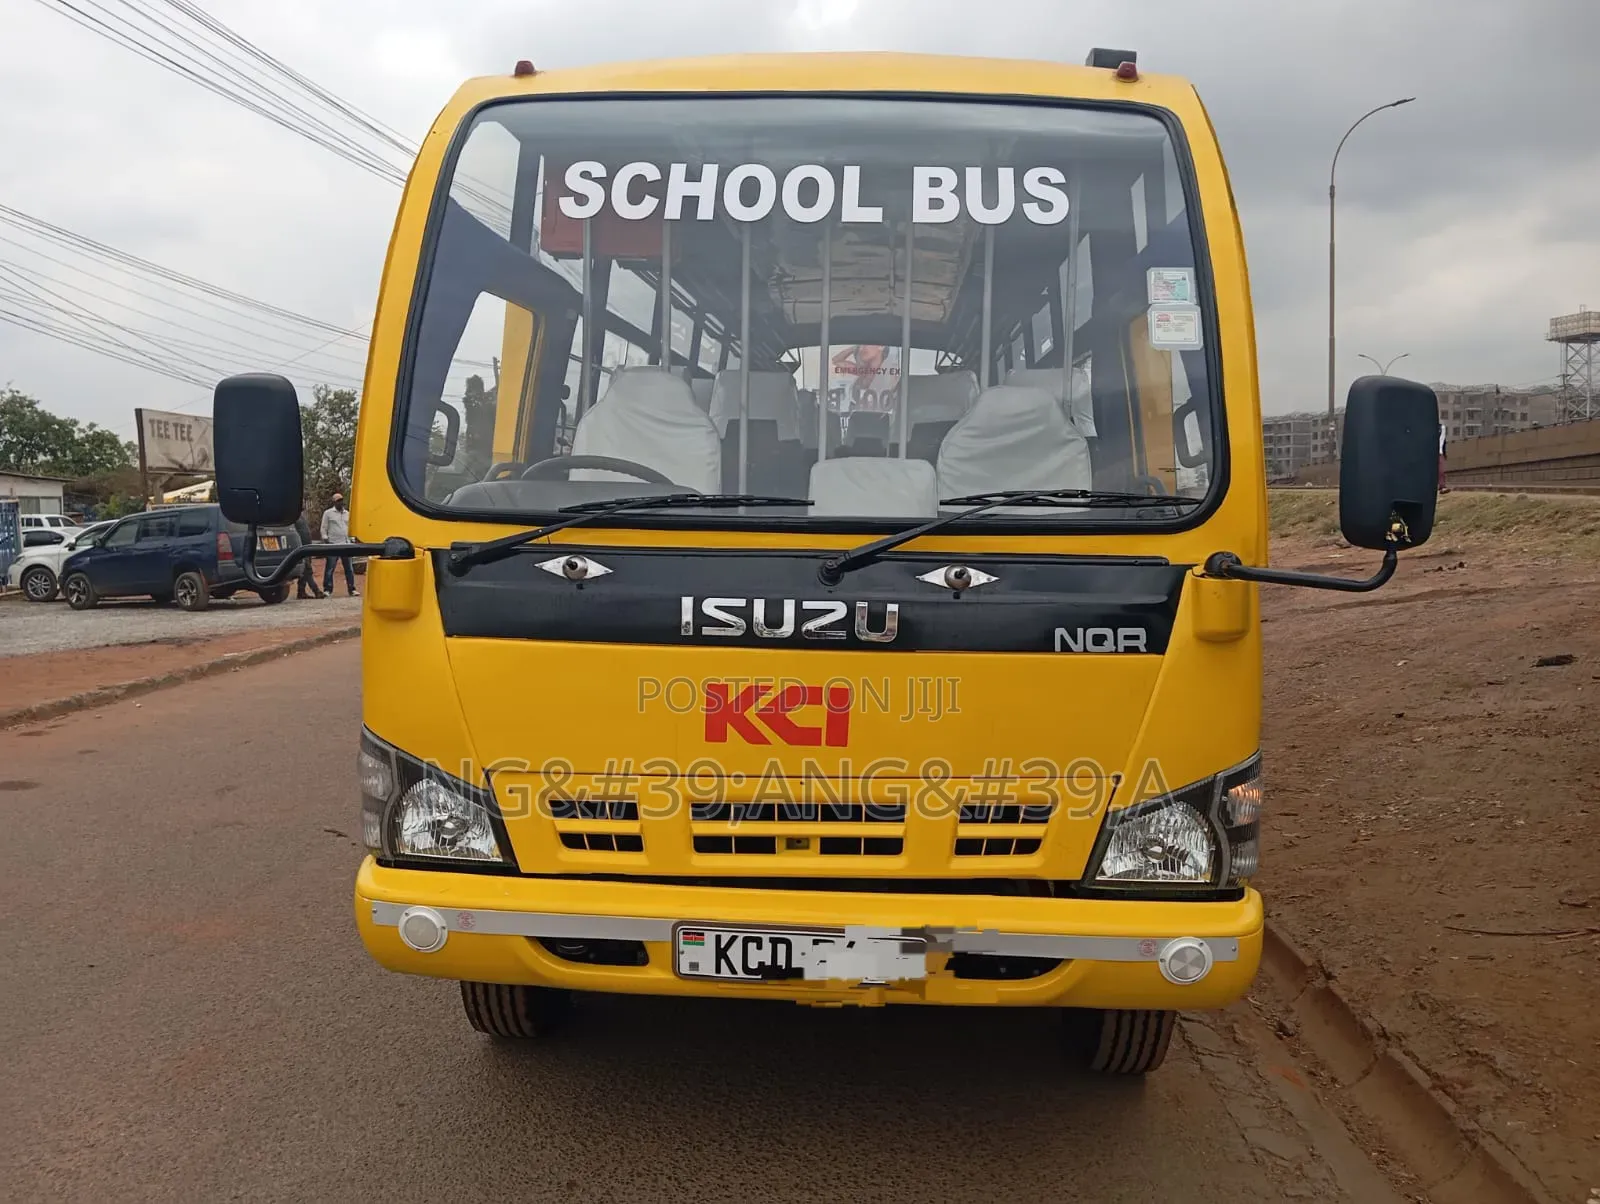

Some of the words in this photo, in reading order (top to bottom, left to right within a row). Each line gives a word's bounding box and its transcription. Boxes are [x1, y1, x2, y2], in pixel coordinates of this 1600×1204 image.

[558, 161, 884, 223] SCHOOL
[912, 165, 1070, 225] BUS
[834, 367, 887, 375] EMERGENCY
[149, 418, 170, 440] TEE
[172, 422, 193, 442] TEE
[680, 596, 899, 643] ISUZU
[1054, 627, 1147, 653] NQR
[704, 683, 850, 747] KCI
